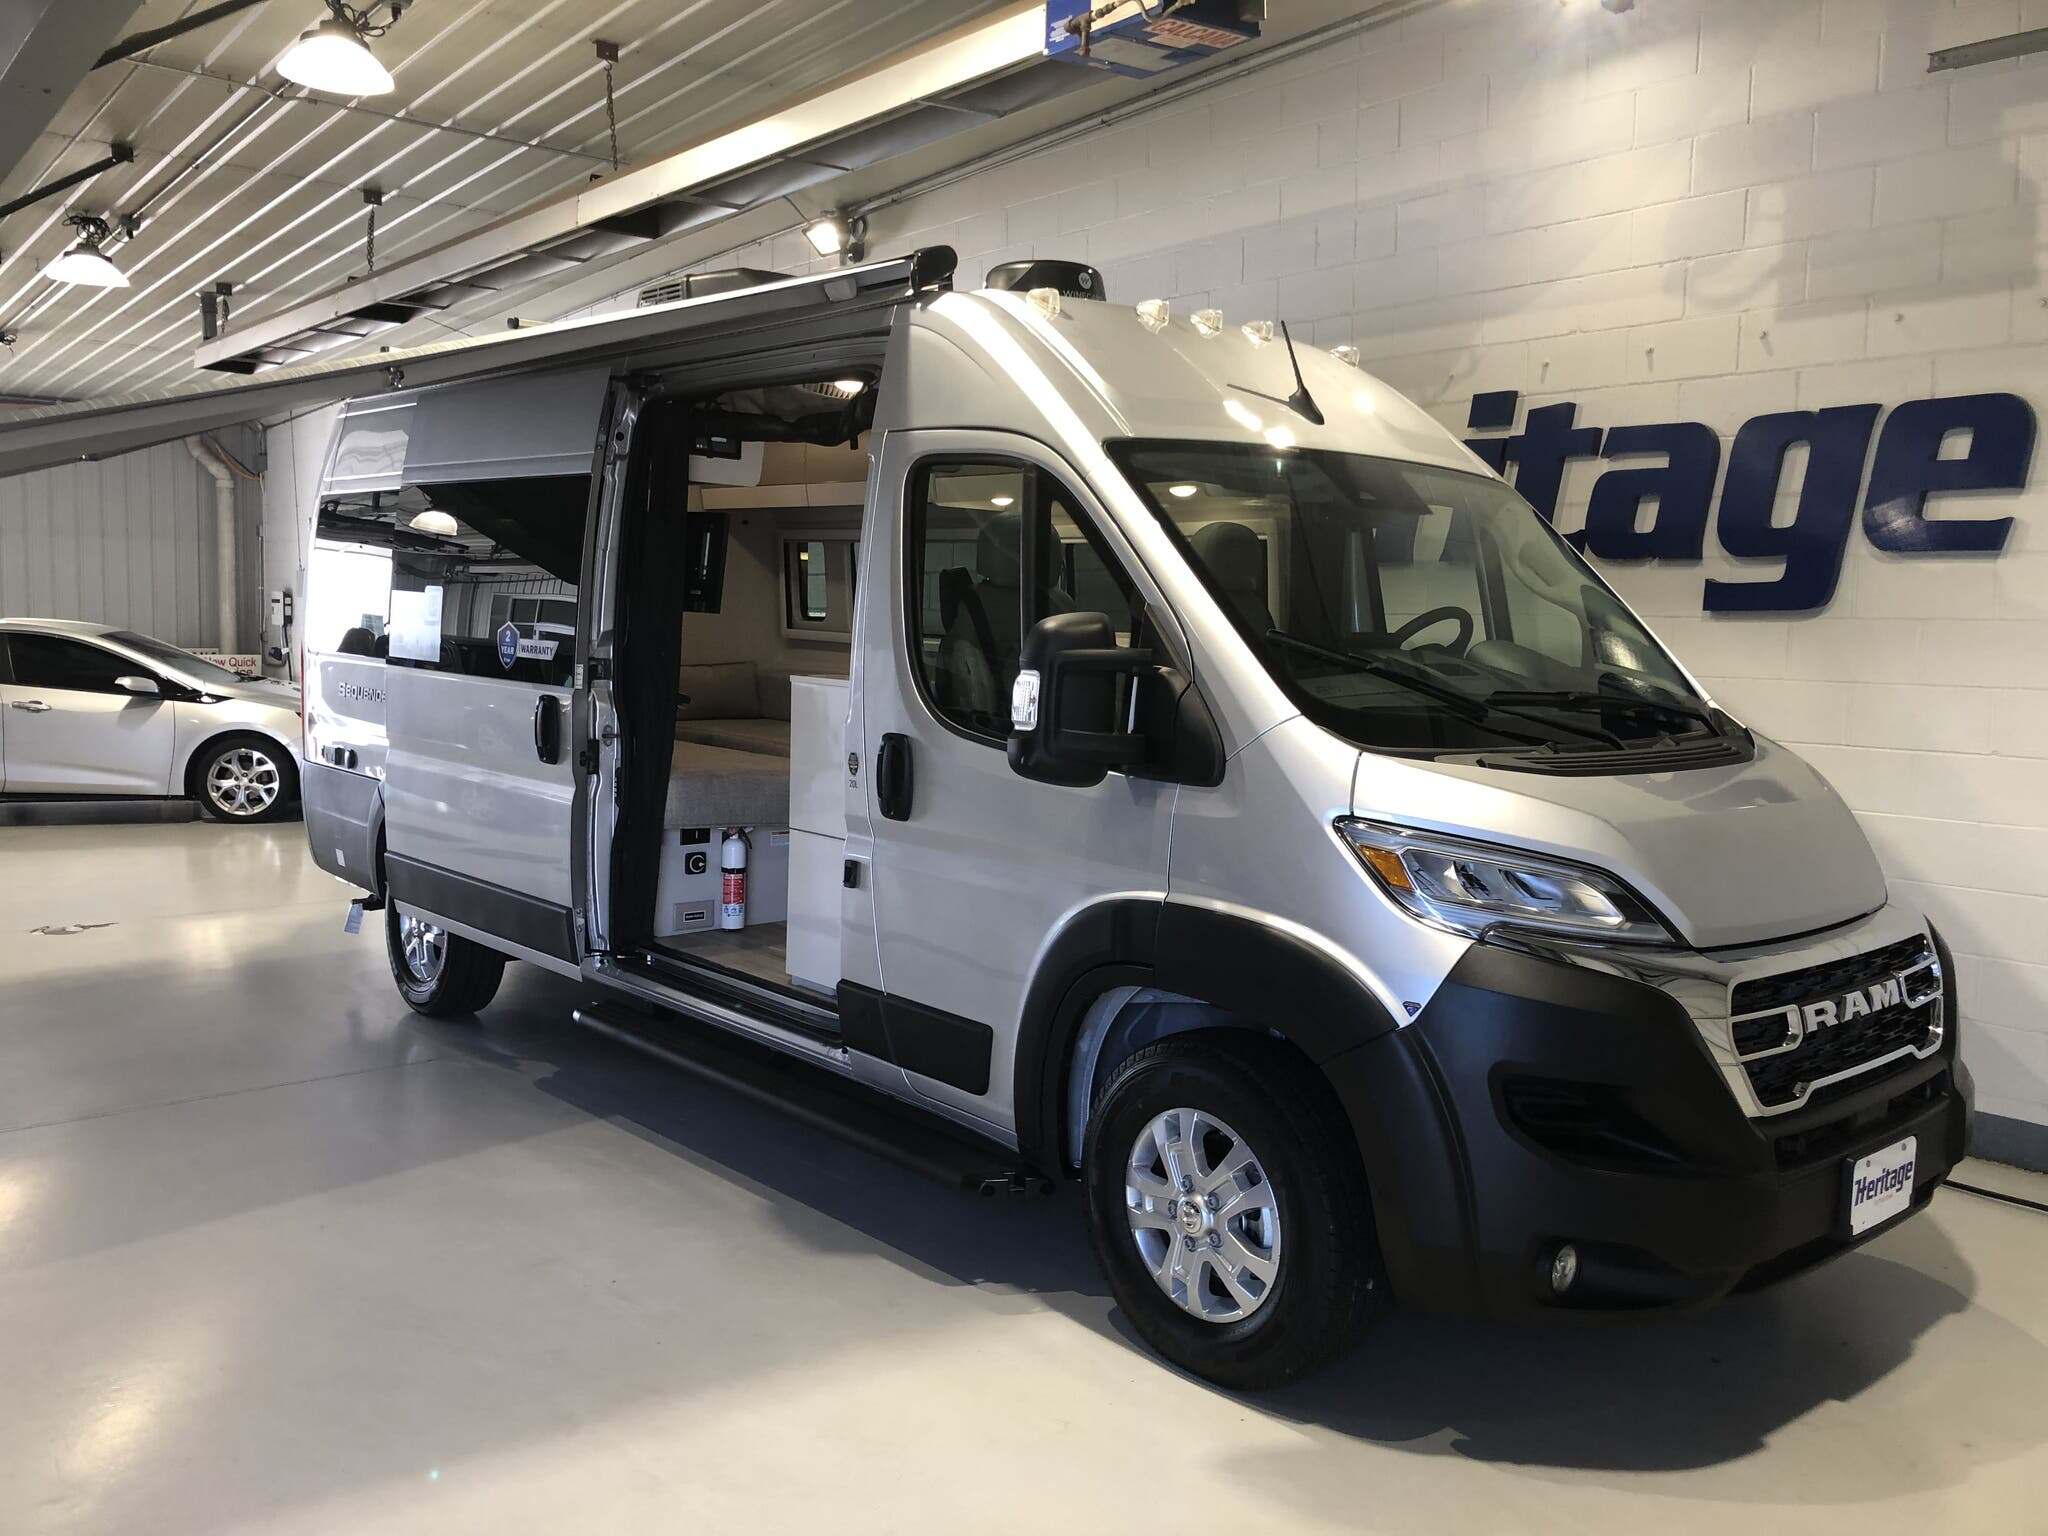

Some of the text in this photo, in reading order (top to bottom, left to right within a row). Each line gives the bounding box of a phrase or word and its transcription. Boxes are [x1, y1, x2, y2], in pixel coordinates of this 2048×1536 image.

[505, 630, 511, 642] 2
[501, 645, 515, 655] YEAR
[521, 644, 554, 656] WARRANTY
[229, 657, 257, 668] Quick
[1803, 979, 1901, 1034] RAM
[1854, 1161, 1914, 1207] Heritage
